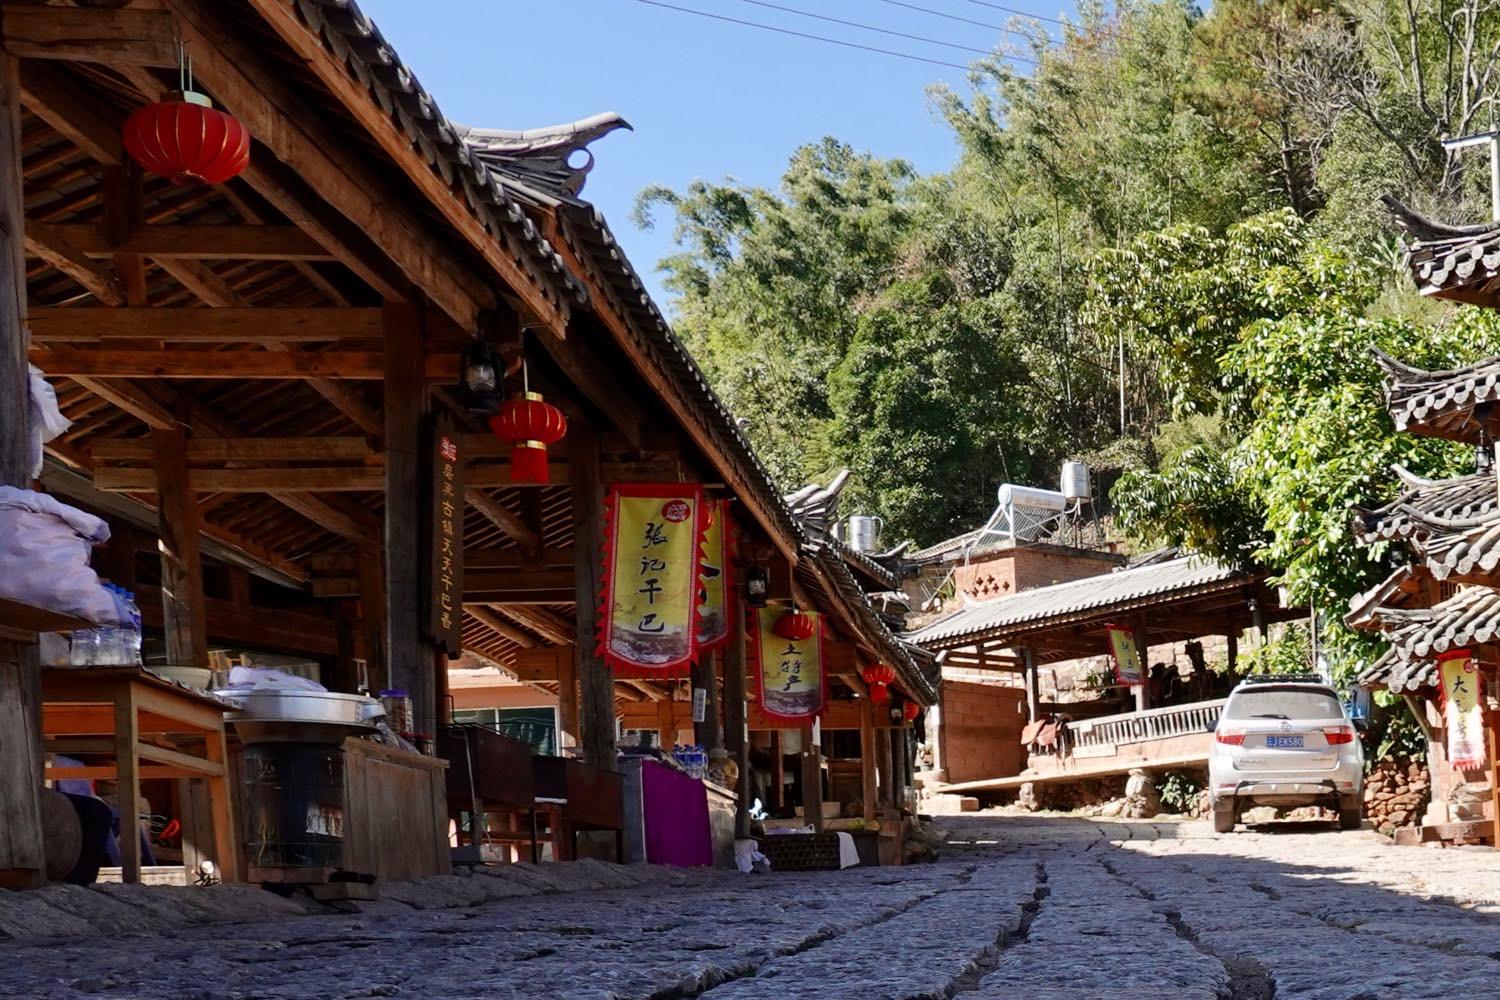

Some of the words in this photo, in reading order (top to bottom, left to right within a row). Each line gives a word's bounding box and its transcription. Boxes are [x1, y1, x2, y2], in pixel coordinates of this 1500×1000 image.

[638, 522, 668, 633] 张记干巴
[781, 642, 803, 692] 土特产
